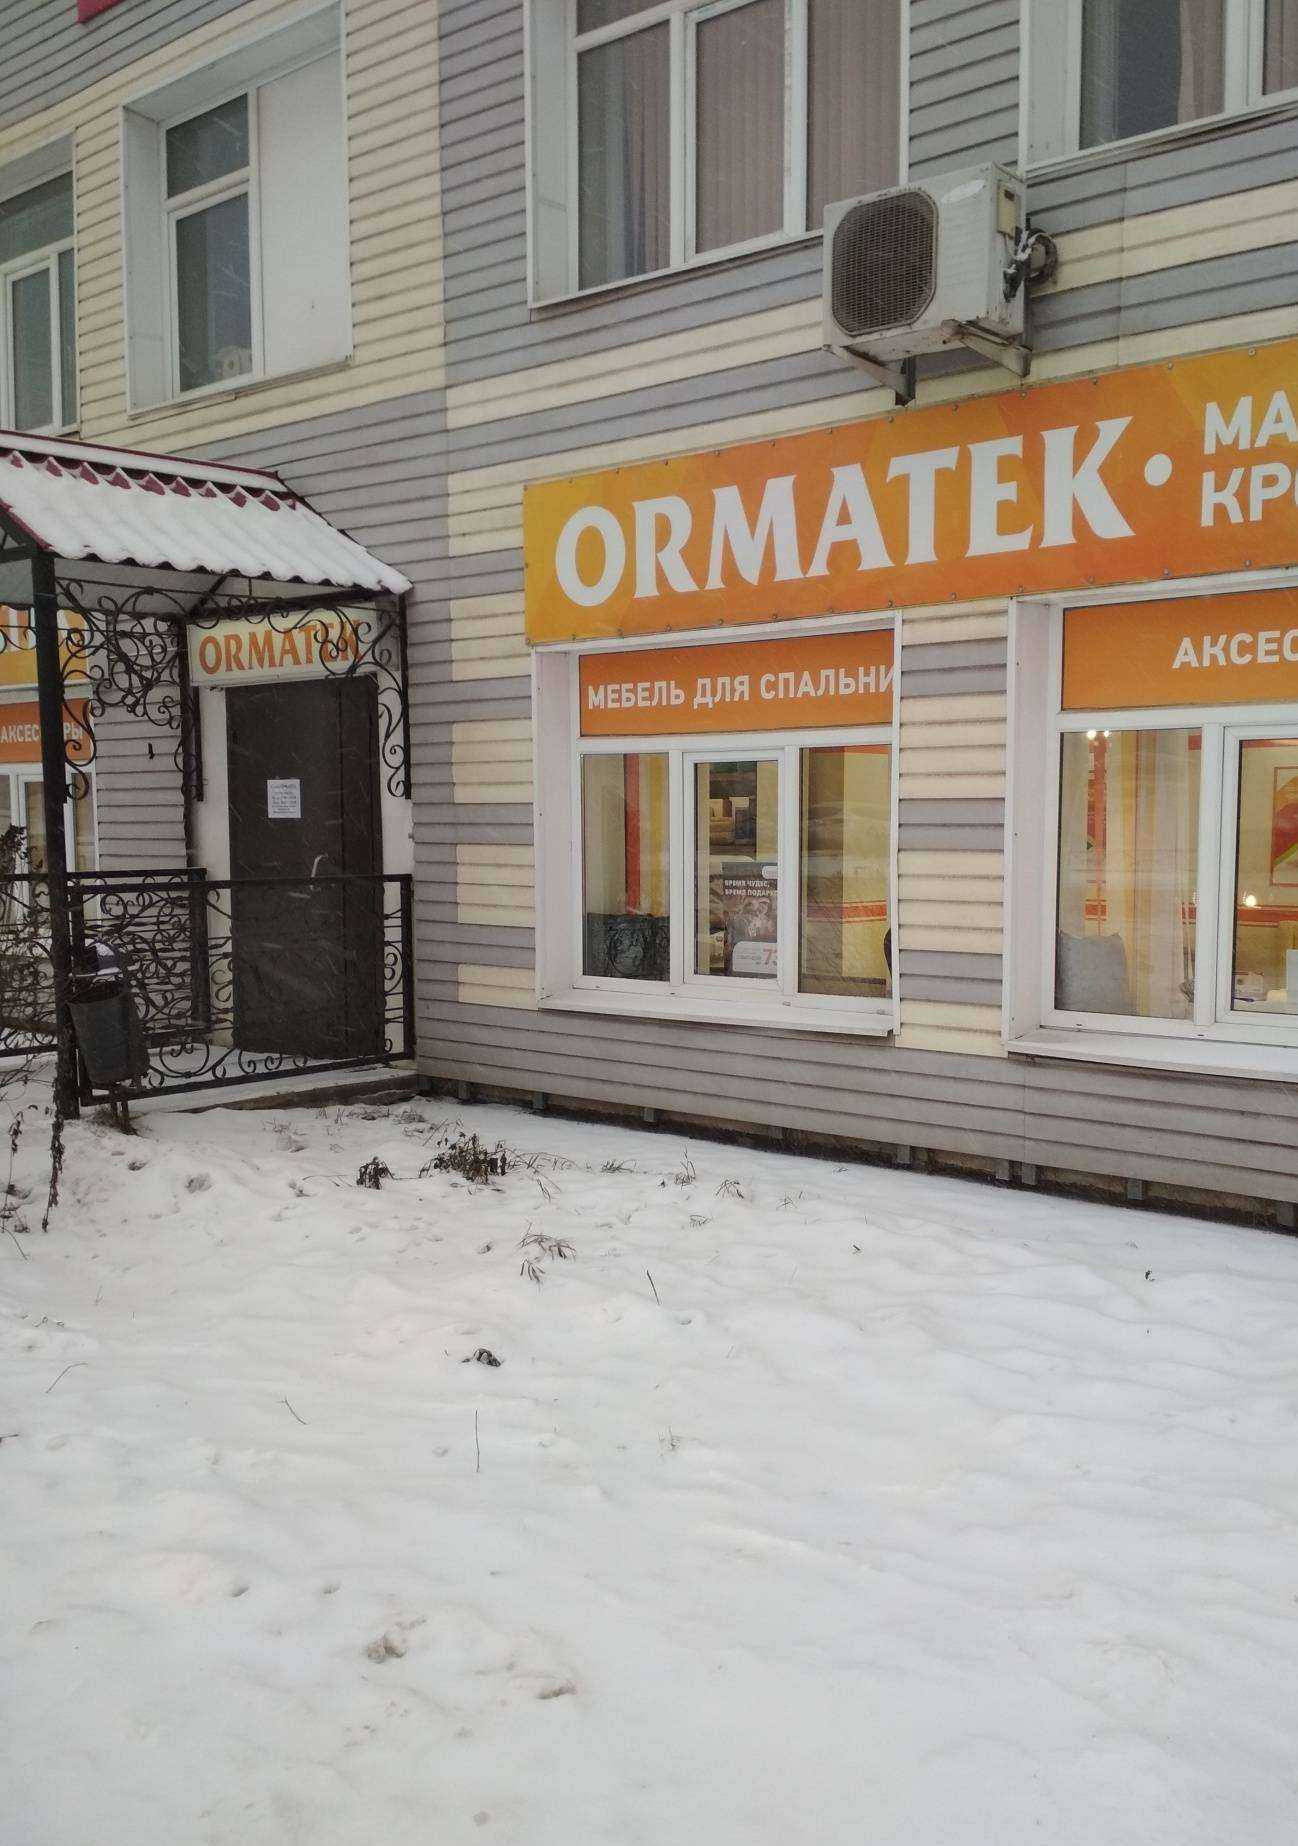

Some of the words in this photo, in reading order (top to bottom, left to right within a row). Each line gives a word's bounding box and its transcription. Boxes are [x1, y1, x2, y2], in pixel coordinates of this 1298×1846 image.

[1203, 389, 1298, 455] МА
[555, 415, 1136, 608] ORMATEK
[1200, 462, 1298, 527] КР
[587, 680, 686, 710] МЕБЕЛЬ
[693, 675, 751, 709] ДЛЯ
[759, 665, 896, 700] СПАЛЬНИ
[0, 722, 83, 744] АКСЕСРЫ
